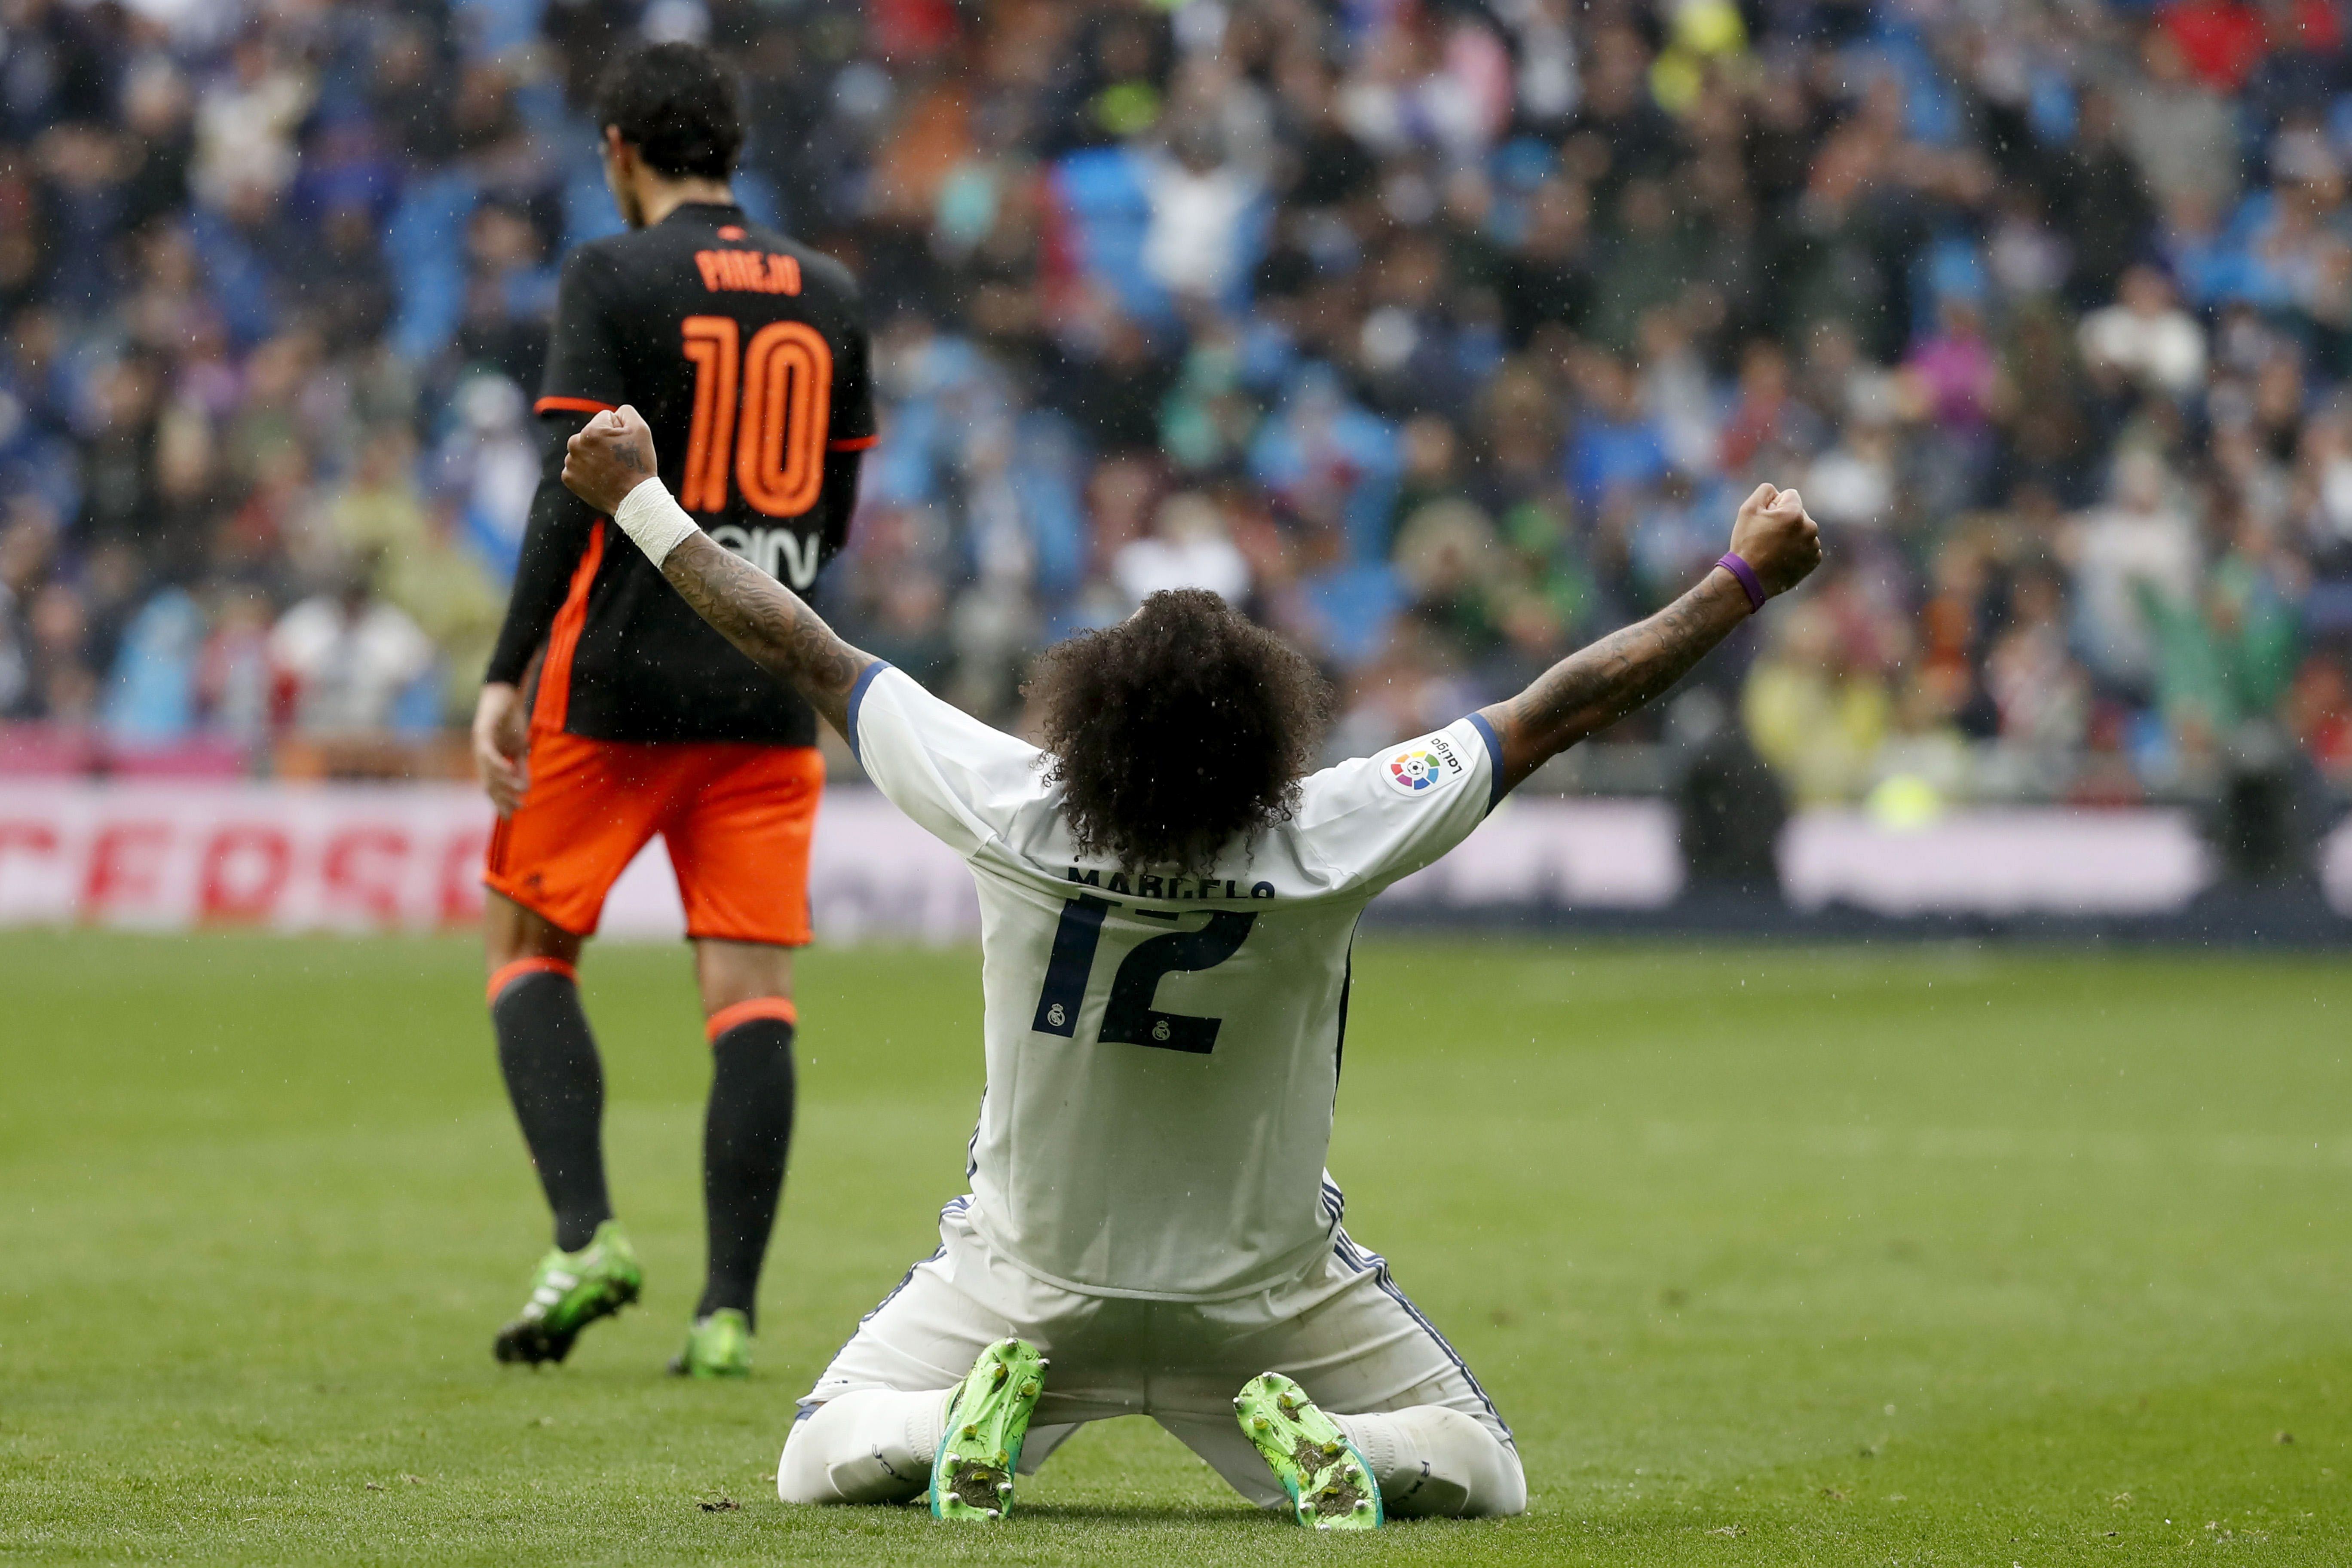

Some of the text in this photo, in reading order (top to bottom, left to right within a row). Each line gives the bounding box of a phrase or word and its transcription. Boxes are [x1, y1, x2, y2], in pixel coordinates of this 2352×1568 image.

[694, 249, 802, 297] PAREJO
[681, 315, 833, 518] 10
[1430, 738, 1463, 775] LaLiga
[1032, 893, 1259, 1054] 12
